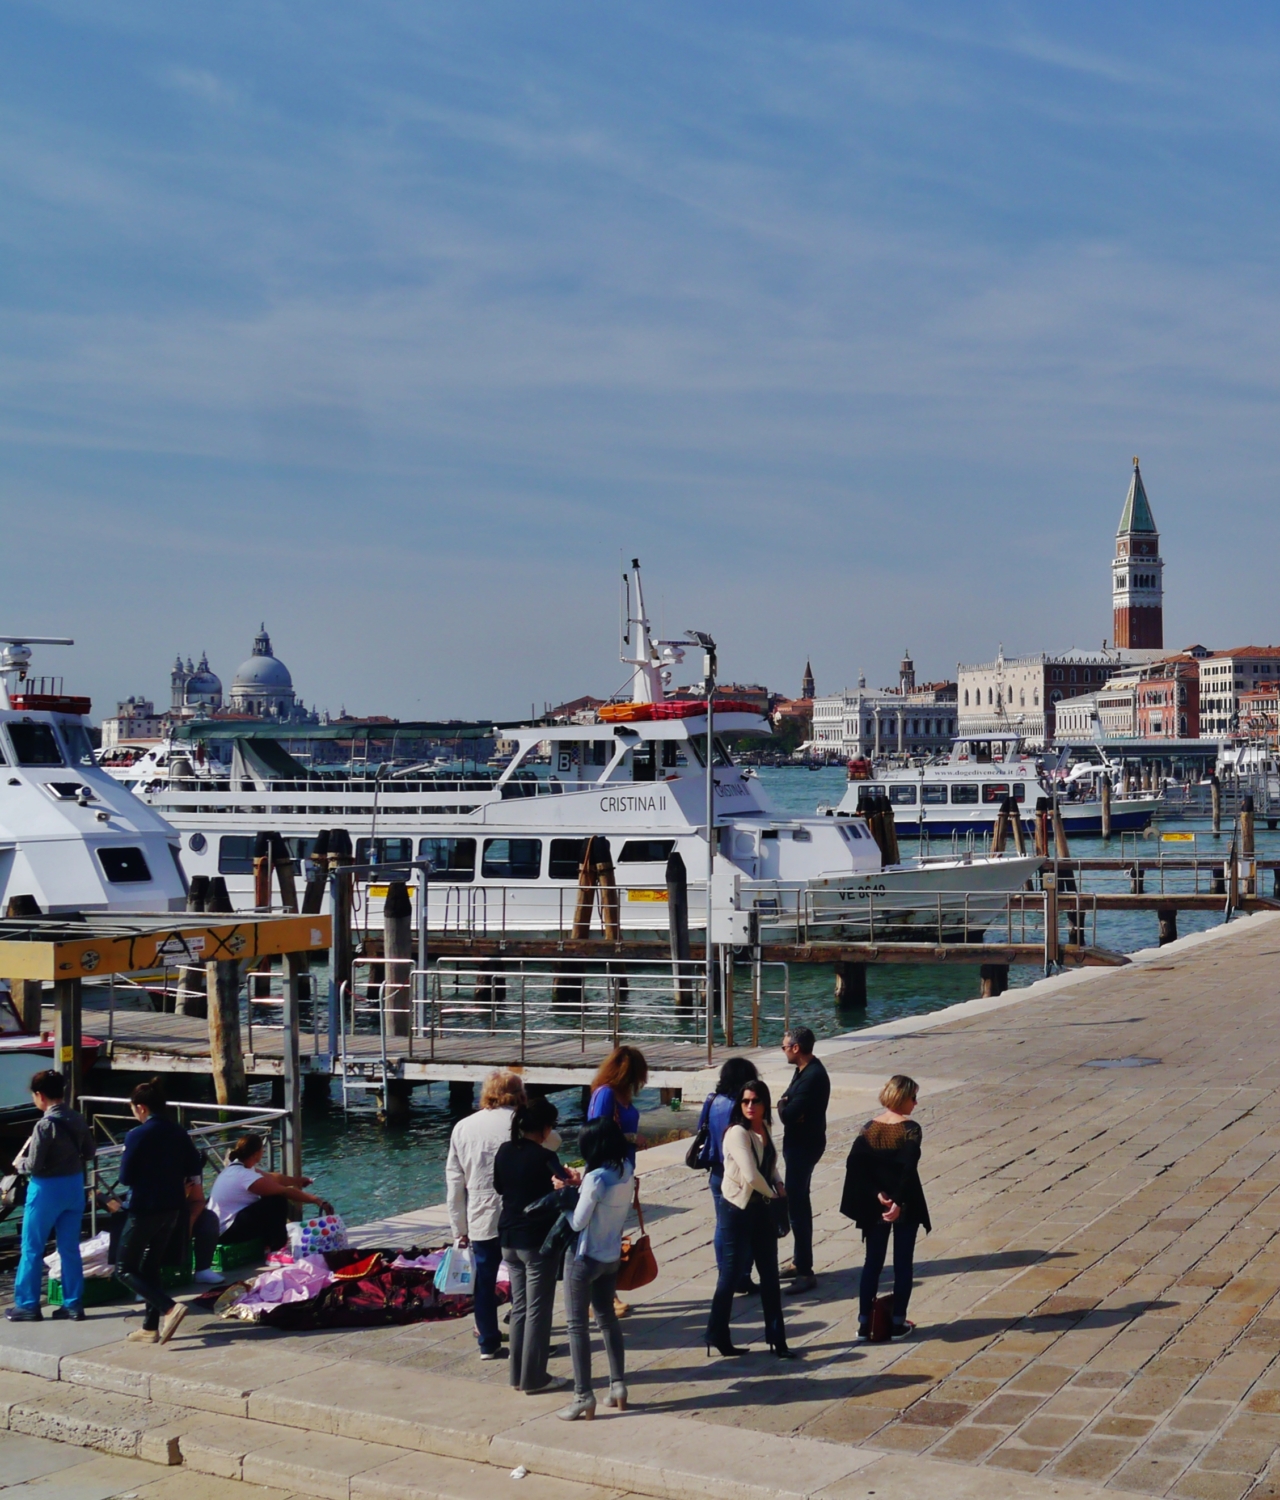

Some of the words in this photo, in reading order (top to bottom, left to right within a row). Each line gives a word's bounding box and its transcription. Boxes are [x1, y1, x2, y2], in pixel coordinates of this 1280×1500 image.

[560, 754, 570, 770] B
[714, 783, 743, 798] CRISTINA
[600, 796, 656, 813] CRISTINA
[659, 796, 667, 811] II
[838, 887, 855, 900] VE
[112, 922, 259, 970] TAXI
